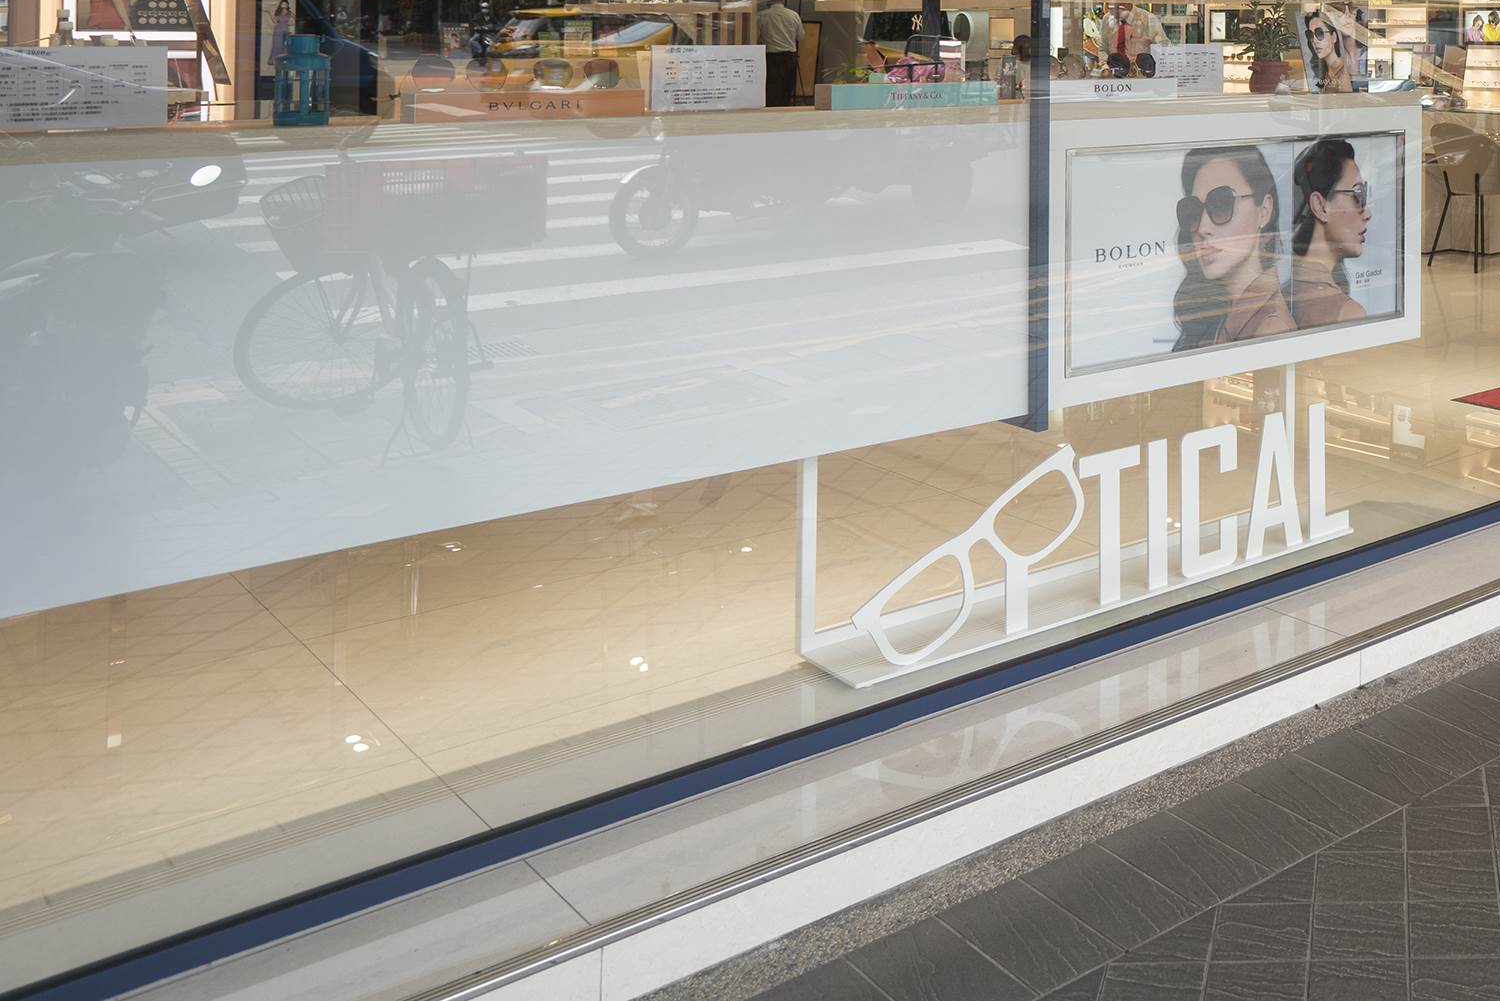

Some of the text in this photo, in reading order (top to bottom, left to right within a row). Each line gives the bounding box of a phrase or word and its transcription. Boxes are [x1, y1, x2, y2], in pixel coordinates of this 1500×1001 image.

[1094, 83, 1132, 93] BOLON
[488, 99, 582, 112] BVLGARI
[1095, 240, 1167, 264] BOLON
